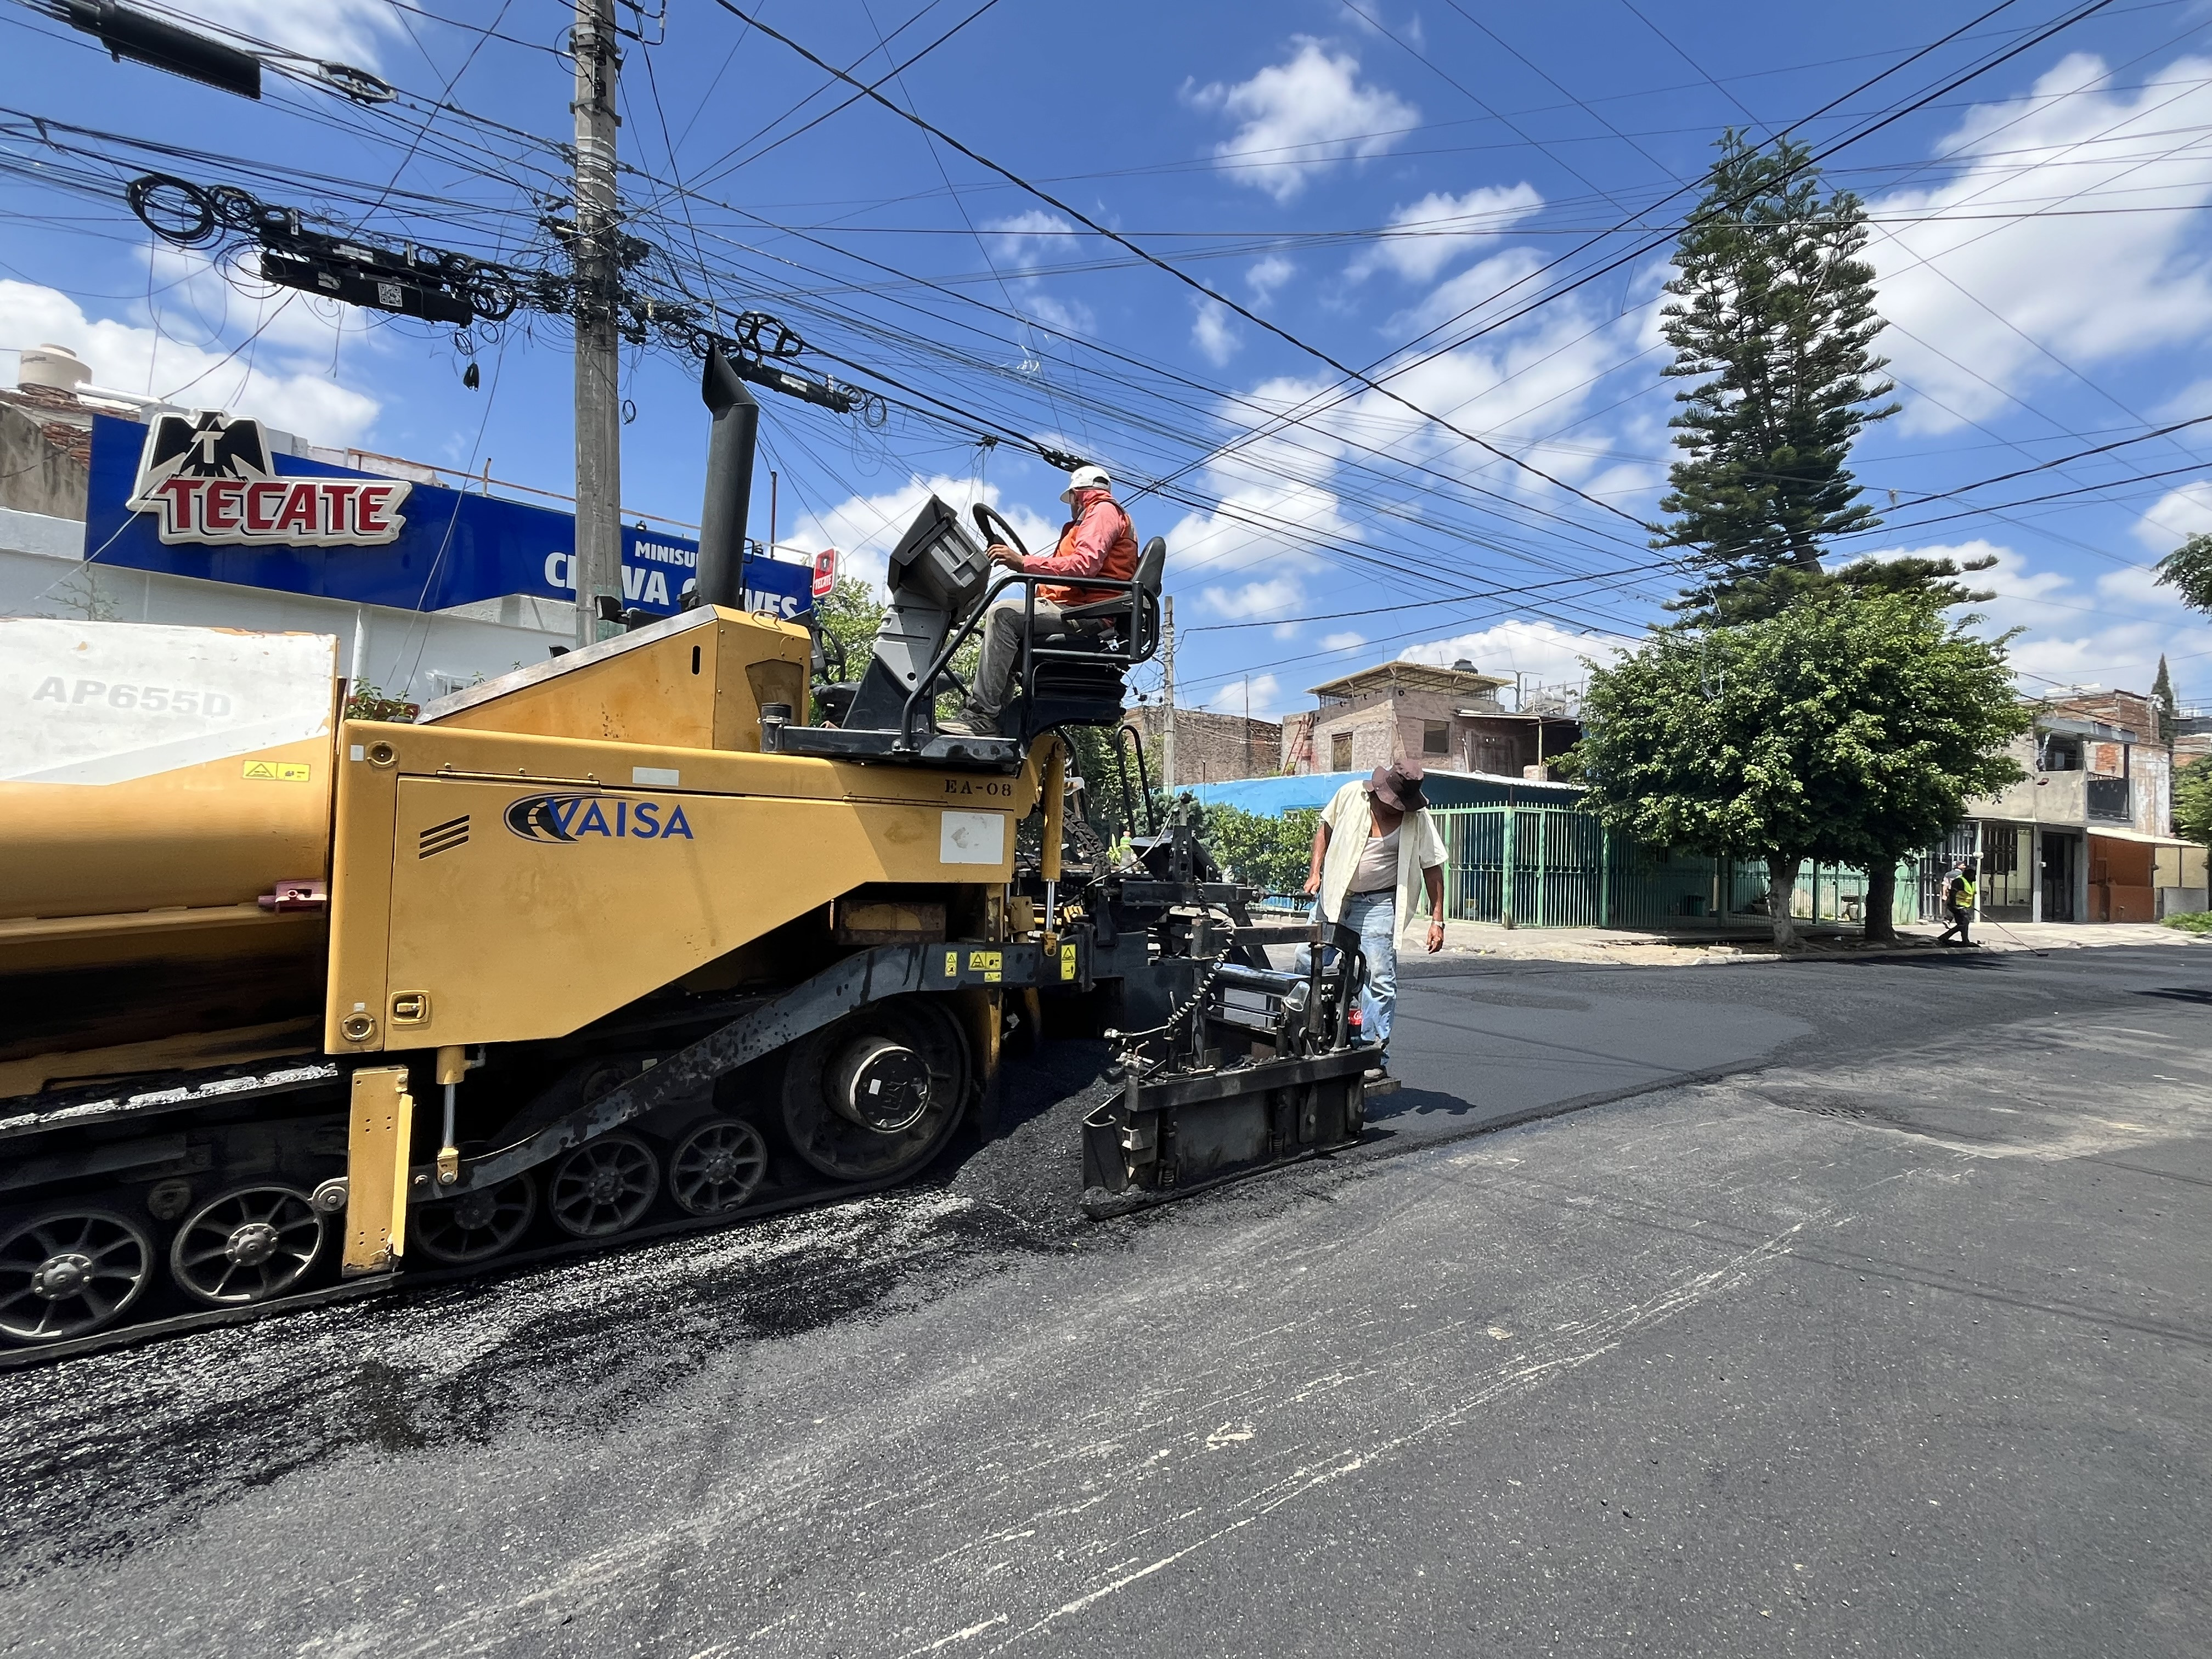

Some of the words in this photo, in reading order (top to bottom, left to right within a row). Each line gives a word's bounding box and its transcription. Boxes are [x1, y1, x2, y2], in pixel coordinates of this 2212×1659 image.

[155, 478, 393, 532] TECATE
[634, 540, 698, 568] MINISU
[544, 552, 669, 606] CVA
[815, 573, 833, 590] TECATE
[32, 675, 231, 716] AP655D
[545, 797, 694, 839] VAISA
